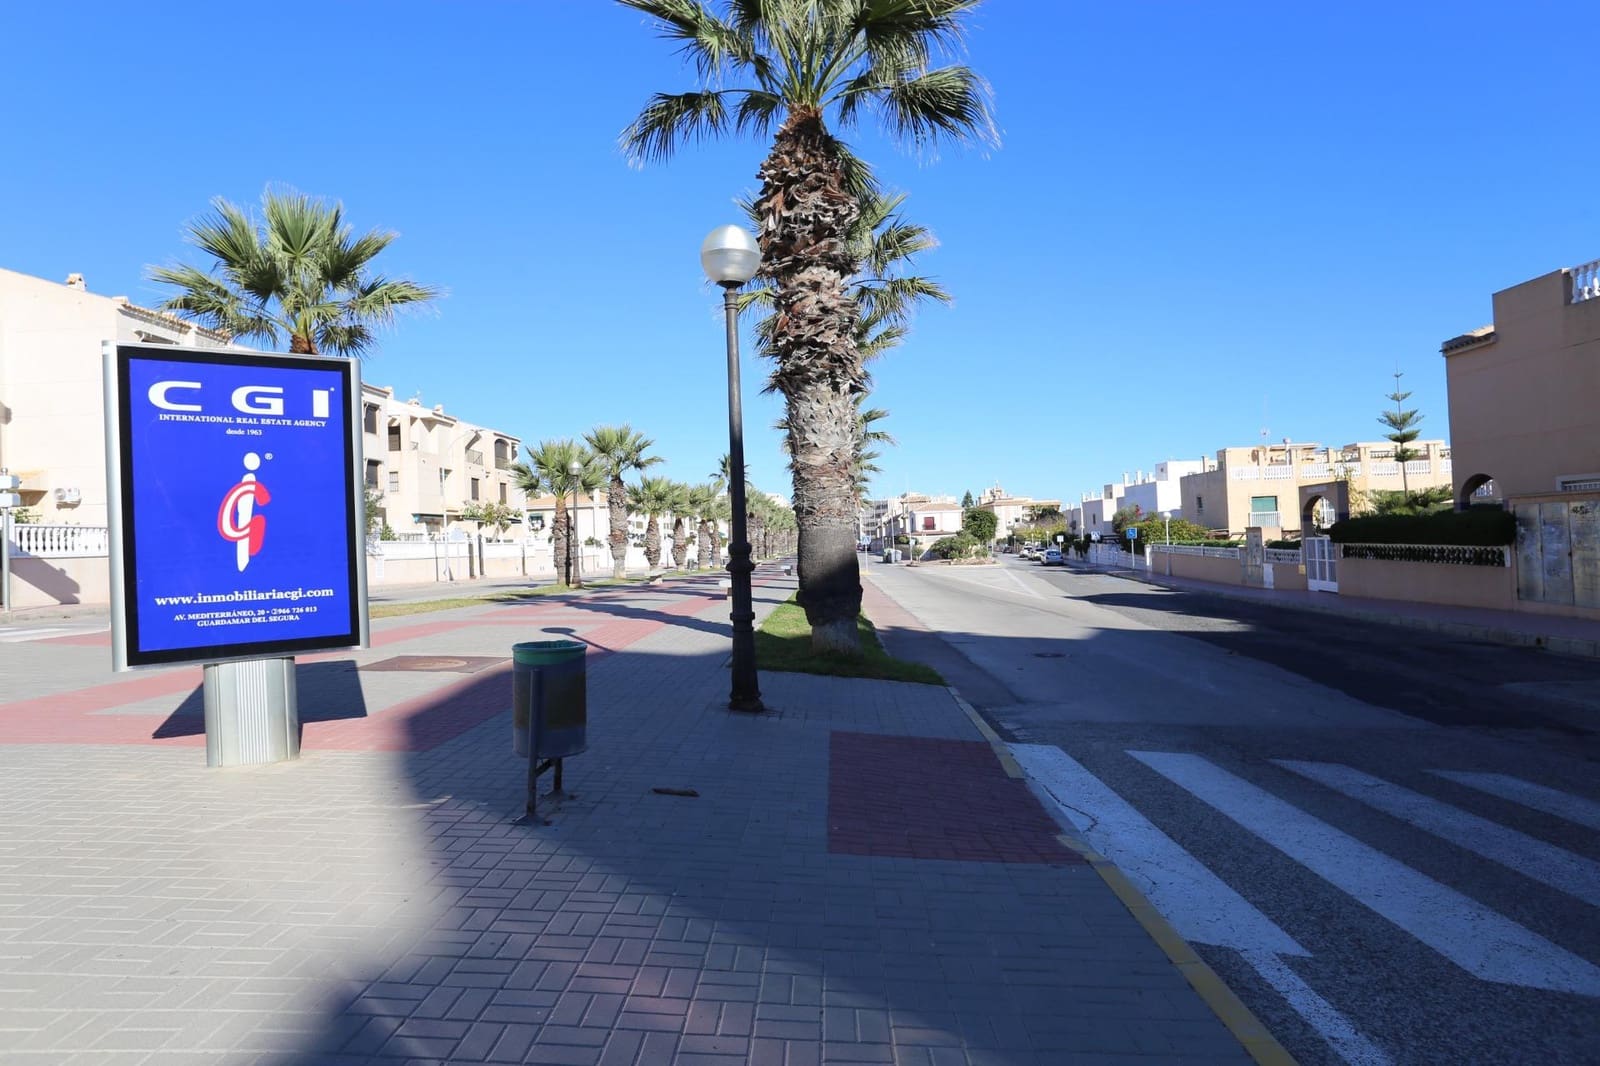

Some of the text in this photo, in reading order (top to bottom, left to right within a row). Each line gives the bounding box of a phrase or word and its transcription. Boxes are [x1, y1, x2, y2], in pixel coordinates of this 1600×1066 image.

[159, 413, 327, 427] INTERNATIONAL REAL ESTATE AGENCY
[226, 427, 245, 435] desde
[154, 587, 334, 606] www.inmobiliariacgi.com
[173, 613, 187, 621] AV.
[196, 614, 300, 627] GUARDAMAR DEL SEGURA
